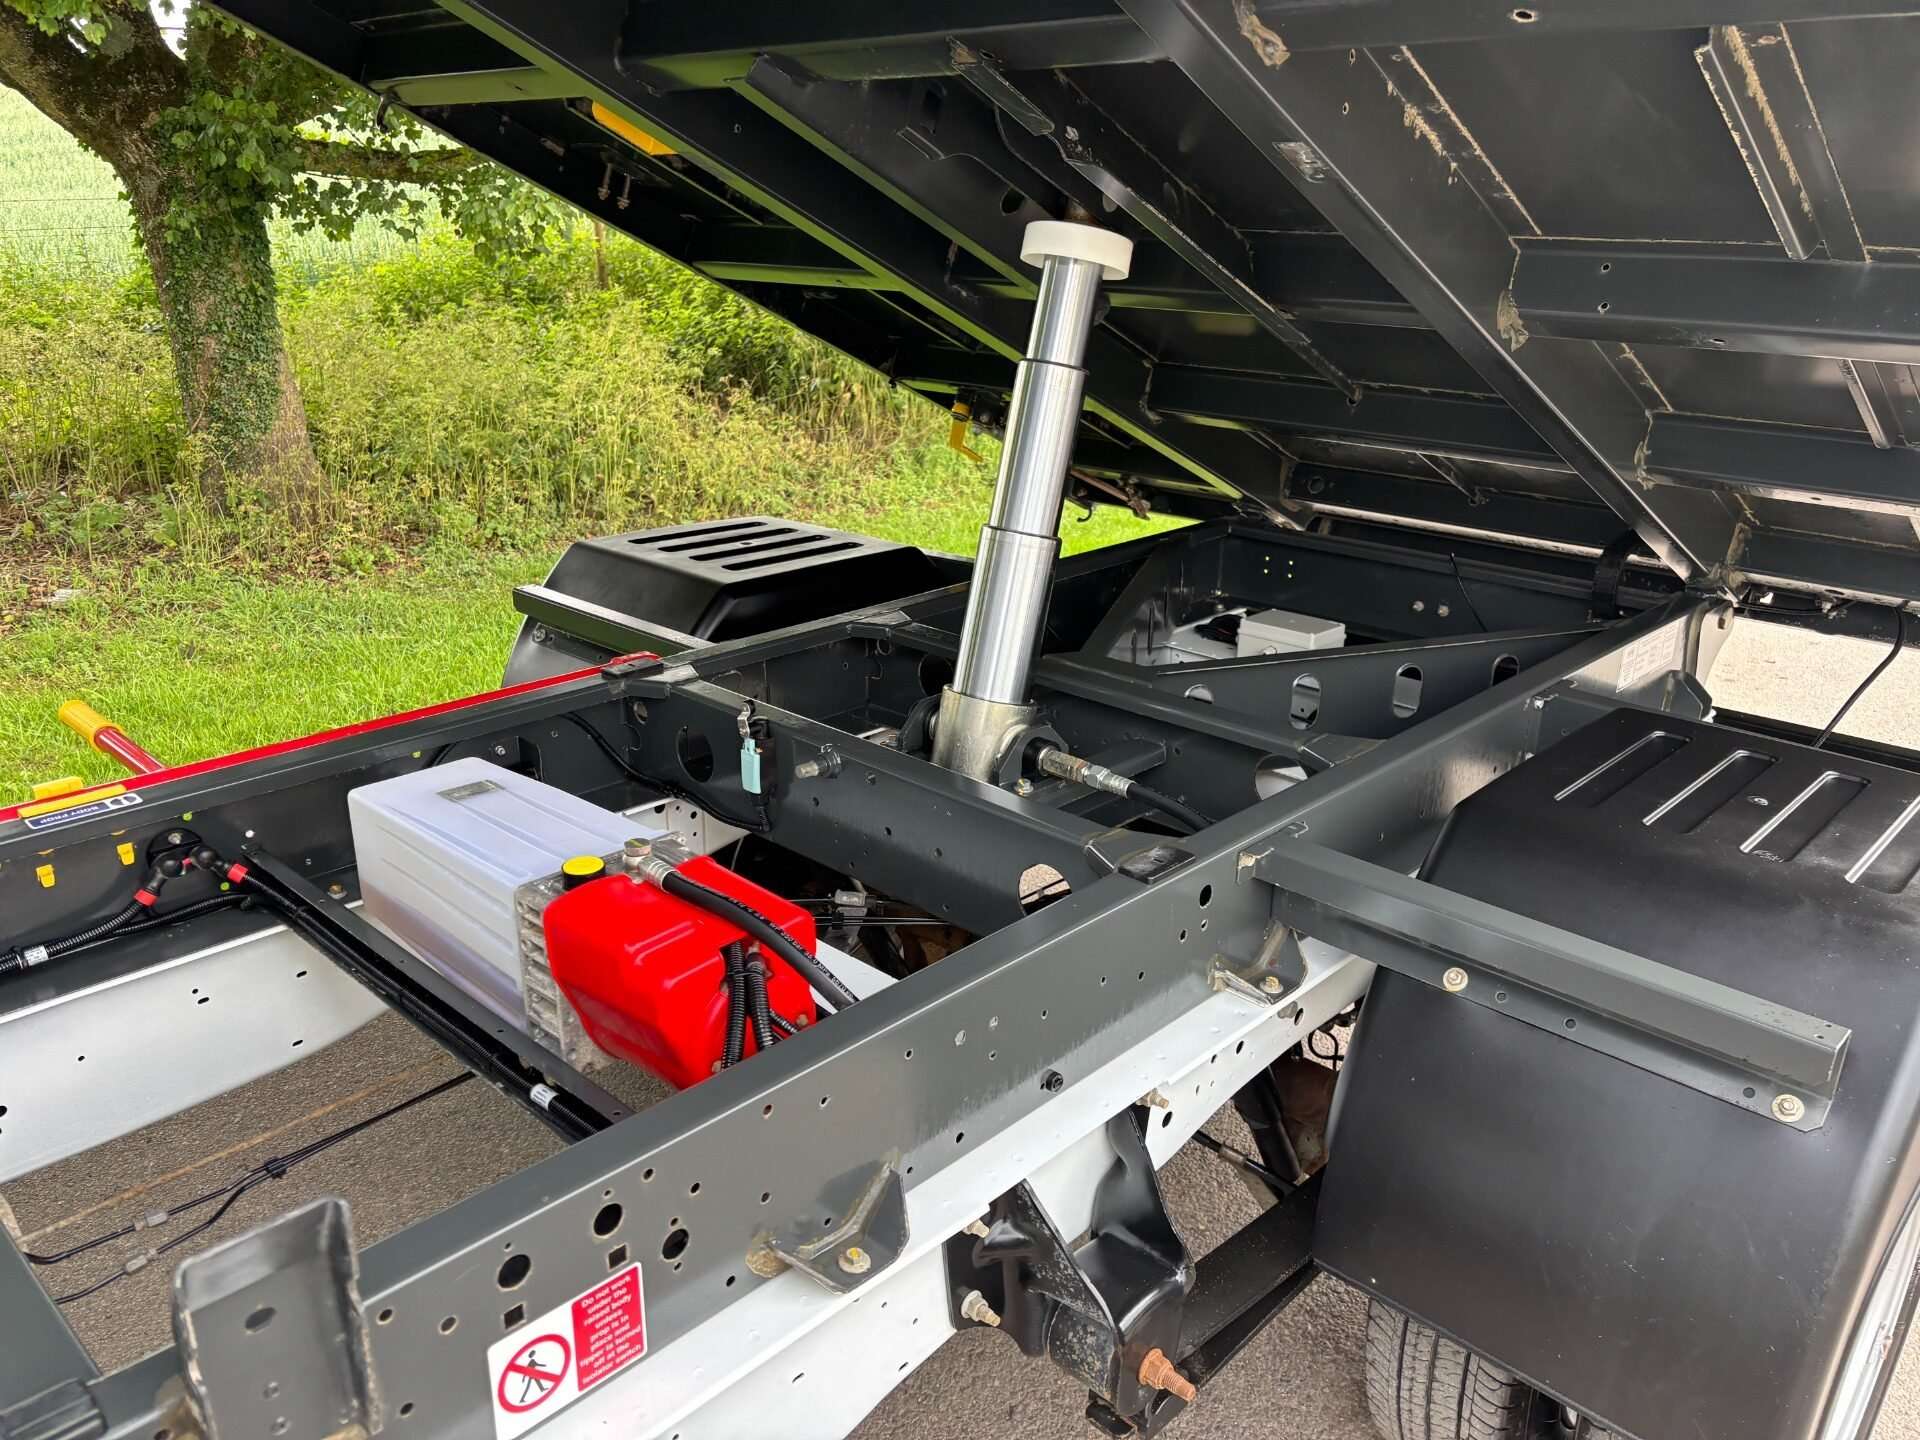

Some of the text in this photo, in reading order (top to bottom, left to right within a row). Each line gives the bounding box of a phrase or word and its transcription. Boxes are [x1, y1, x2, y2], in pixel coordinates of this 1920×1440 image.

[40, 805, 99, 823] BODY PROP
[581, 1275, 631, 1308] Do not work
[587, 1287, 628, 1315] under the
[583, 1293, 632, 1327] raised body
[595, 1309, 623, 1329] unless
[590, 1314, 629, 1344] prop is in
[590, 1321, 631, 1353] place and
[580, 1324, 642, 1368] tipper is turned
[593, 1342, 630, 1369] off at the
[615, 1344, 642, 1364] switch
